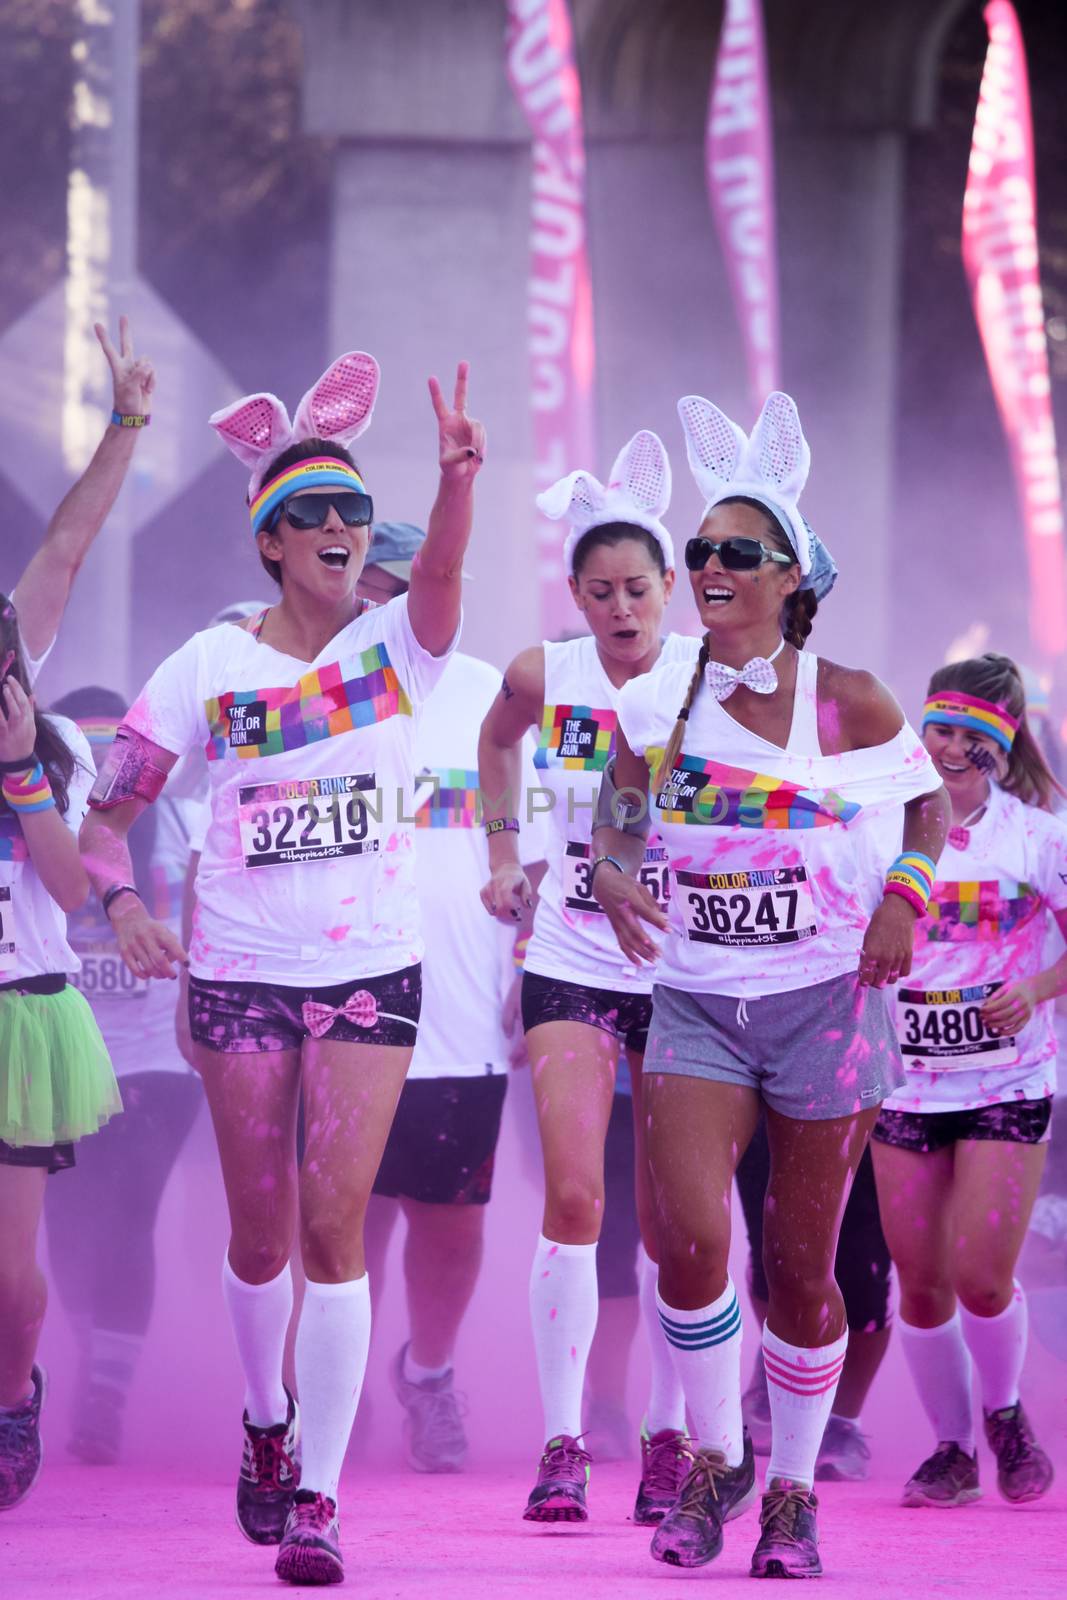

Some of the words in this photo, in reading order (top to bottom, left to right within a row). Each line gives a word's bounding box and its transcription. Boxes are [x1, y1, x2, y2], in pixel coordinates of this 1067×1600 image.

[229, 705, 248, 719] THE
[231, 716, 260, 732] COLOR
[565, 719, 582, 733] THE
[231, 731, 248, 745] RUN
[563, 732, 592, 745] COLOR
[560, 744, 579, 757] RUN
[671, 768, 691, 785] THE
[278, 780, 319, 800] COLOR
[320, 776, 347, 796] RUN
[662, 780, 698, 798] COLOR
[658, 793, 679, 809] RUN
[251, 798, 369, 853] 32219
[709, 871, 749, 889] COLOR
[749, 868, 776, 887] RUN
[688, 889, 798, 934] 36247
[925, 989, 961, 1005] COLOR
